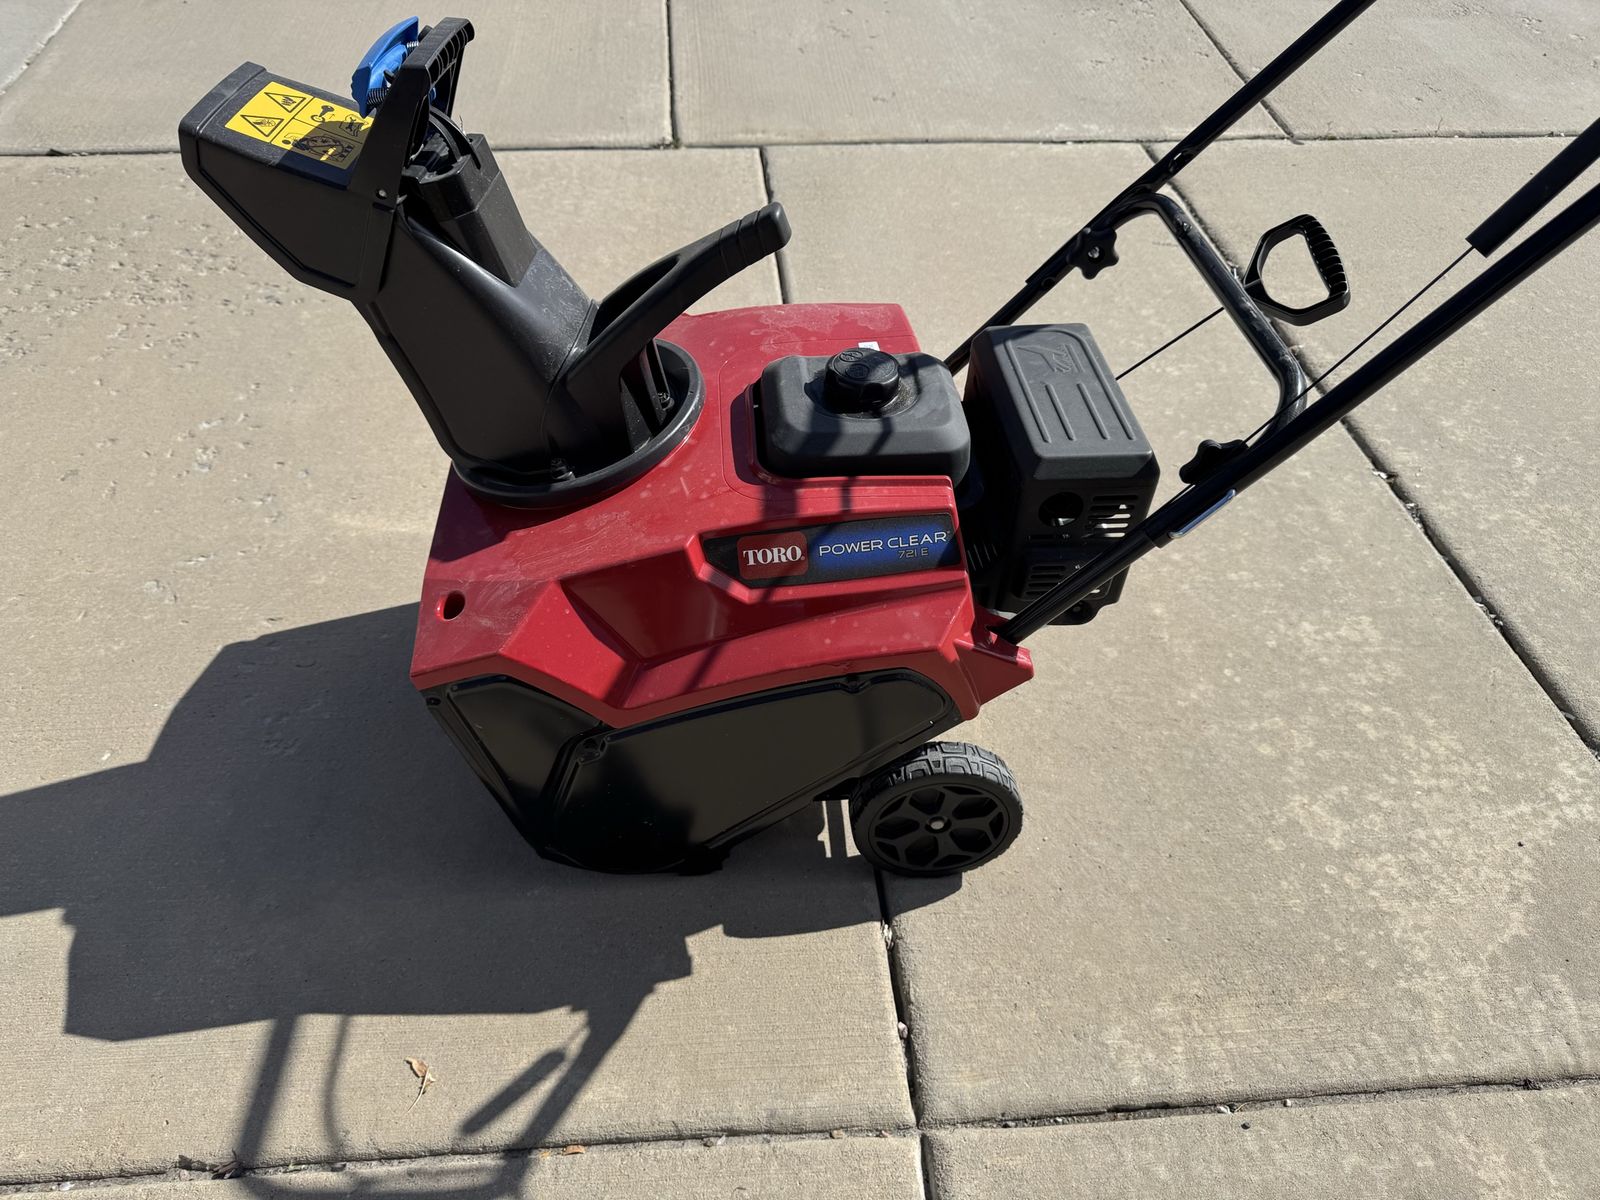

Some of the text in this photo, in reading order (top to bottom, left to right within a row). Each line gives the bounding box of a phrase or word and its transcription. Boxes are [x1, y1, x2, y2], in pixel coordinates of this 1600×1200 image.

[819, 531, 947, 557] POWER CLEAR
[898, 547, 929, 559] 721 E
[743, 545, 802, 566] TORO
